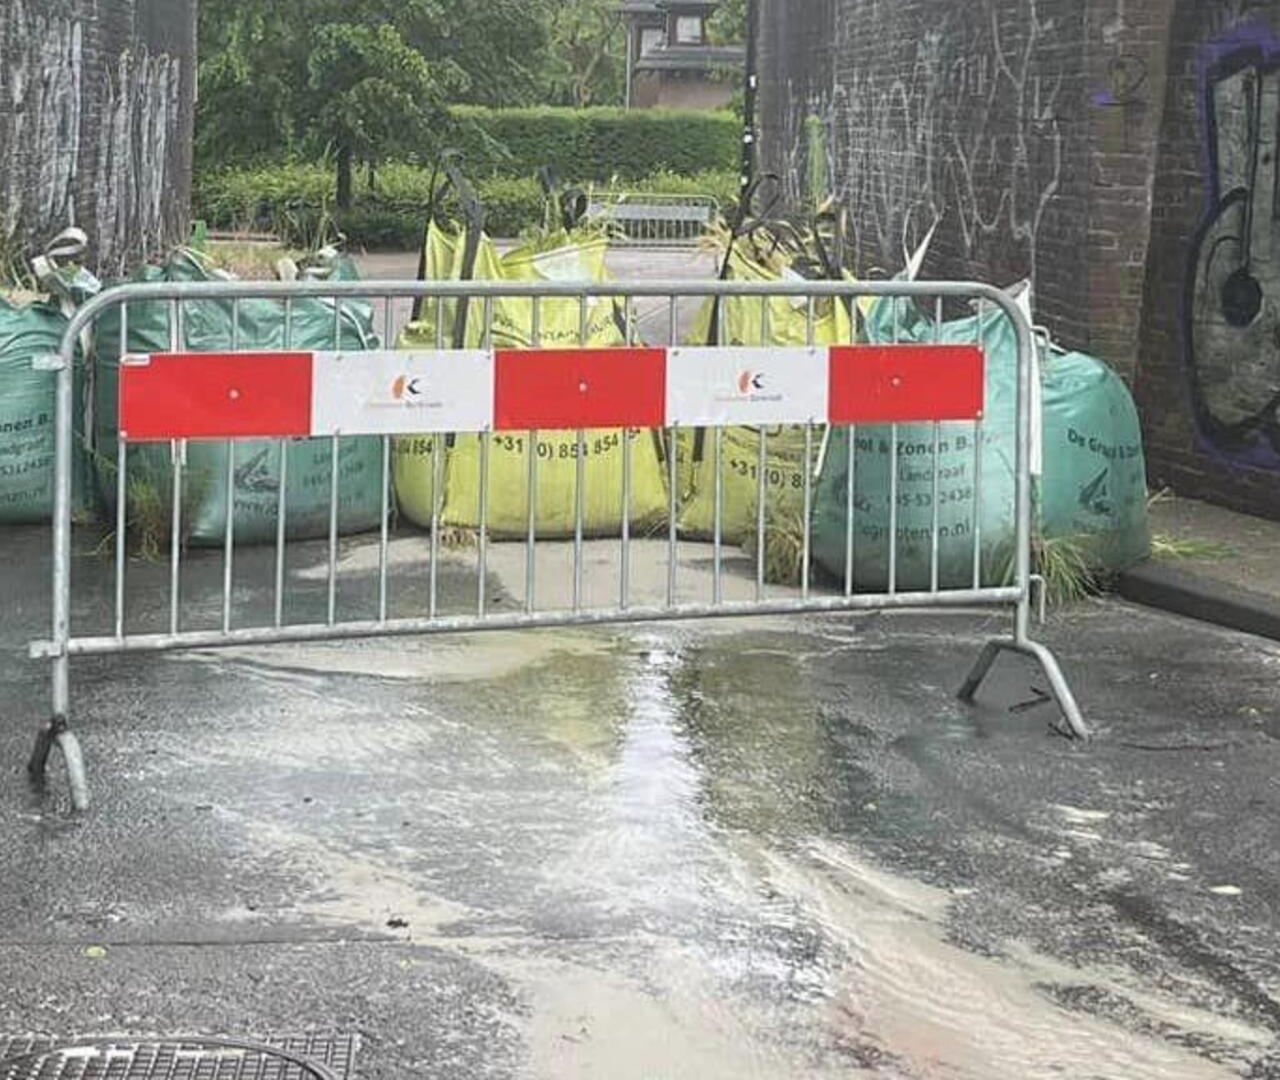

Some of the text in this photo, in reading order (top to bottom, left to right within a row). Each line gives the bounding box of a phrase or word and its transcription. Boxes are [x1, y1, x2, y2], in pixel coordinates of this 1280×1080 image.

[492, 434, 524, 454] +31
[535, 441, 554, 461] 0)
[1067, 427, 1085, 448] De
[729, 459, 757, 480] +31
